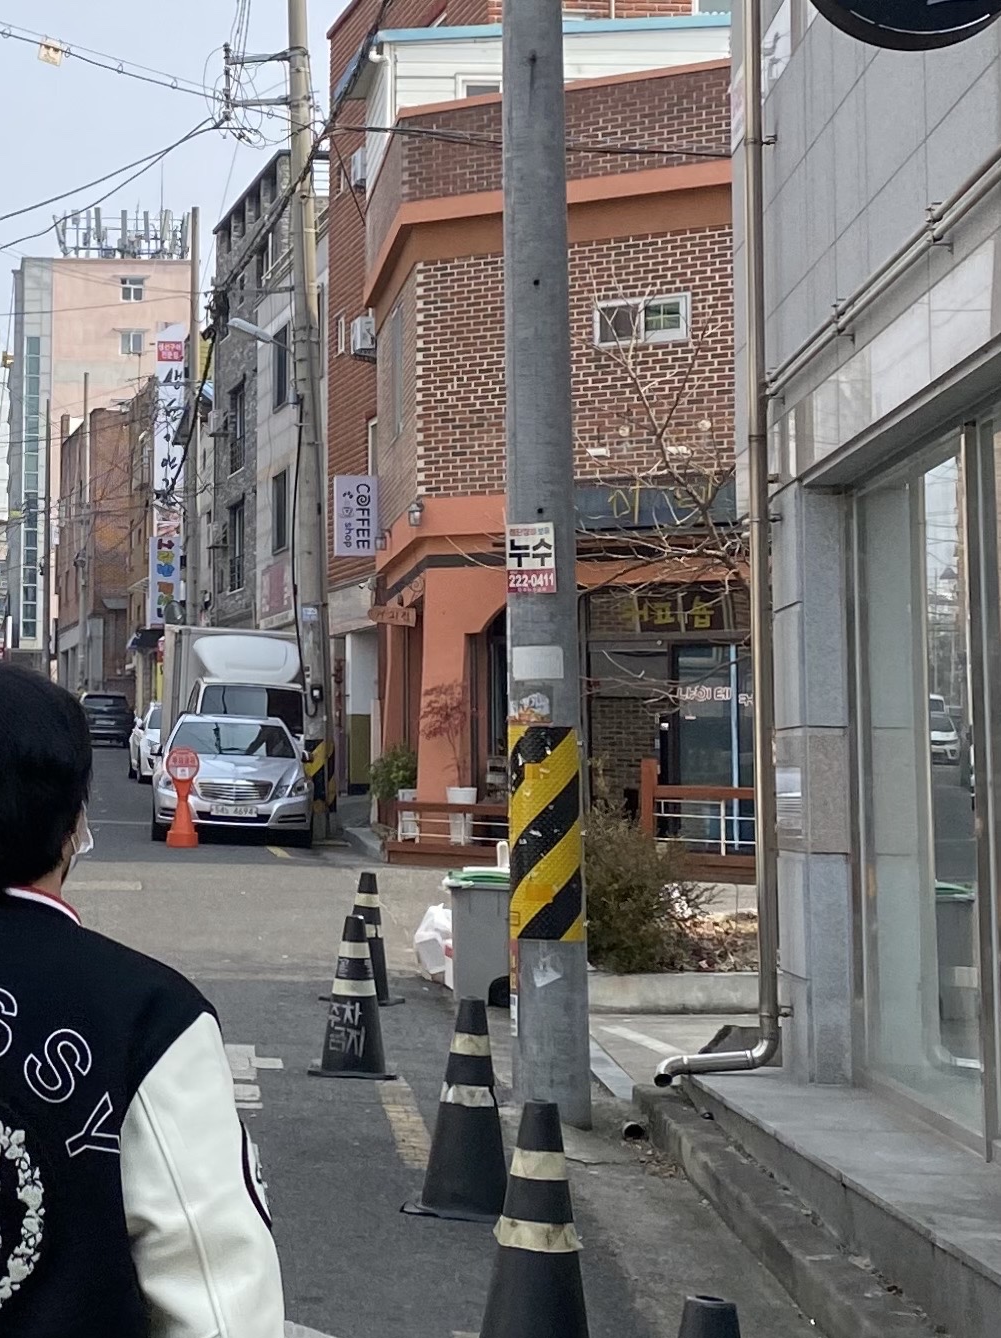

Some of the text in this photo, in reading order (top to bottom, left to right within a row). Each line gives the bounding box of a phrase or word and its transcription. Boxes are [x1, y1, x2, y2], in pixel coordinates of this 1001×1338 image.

[343, 522, 354, 548] shop
[509, 537, 553, 568] 누수
[508, 572, 554, 588] 222-0411
[676, 685, 732, 702] 나이테
[328, 1000, 363, 1028] 주차
[328, 1025, 366, 1058] 금지
